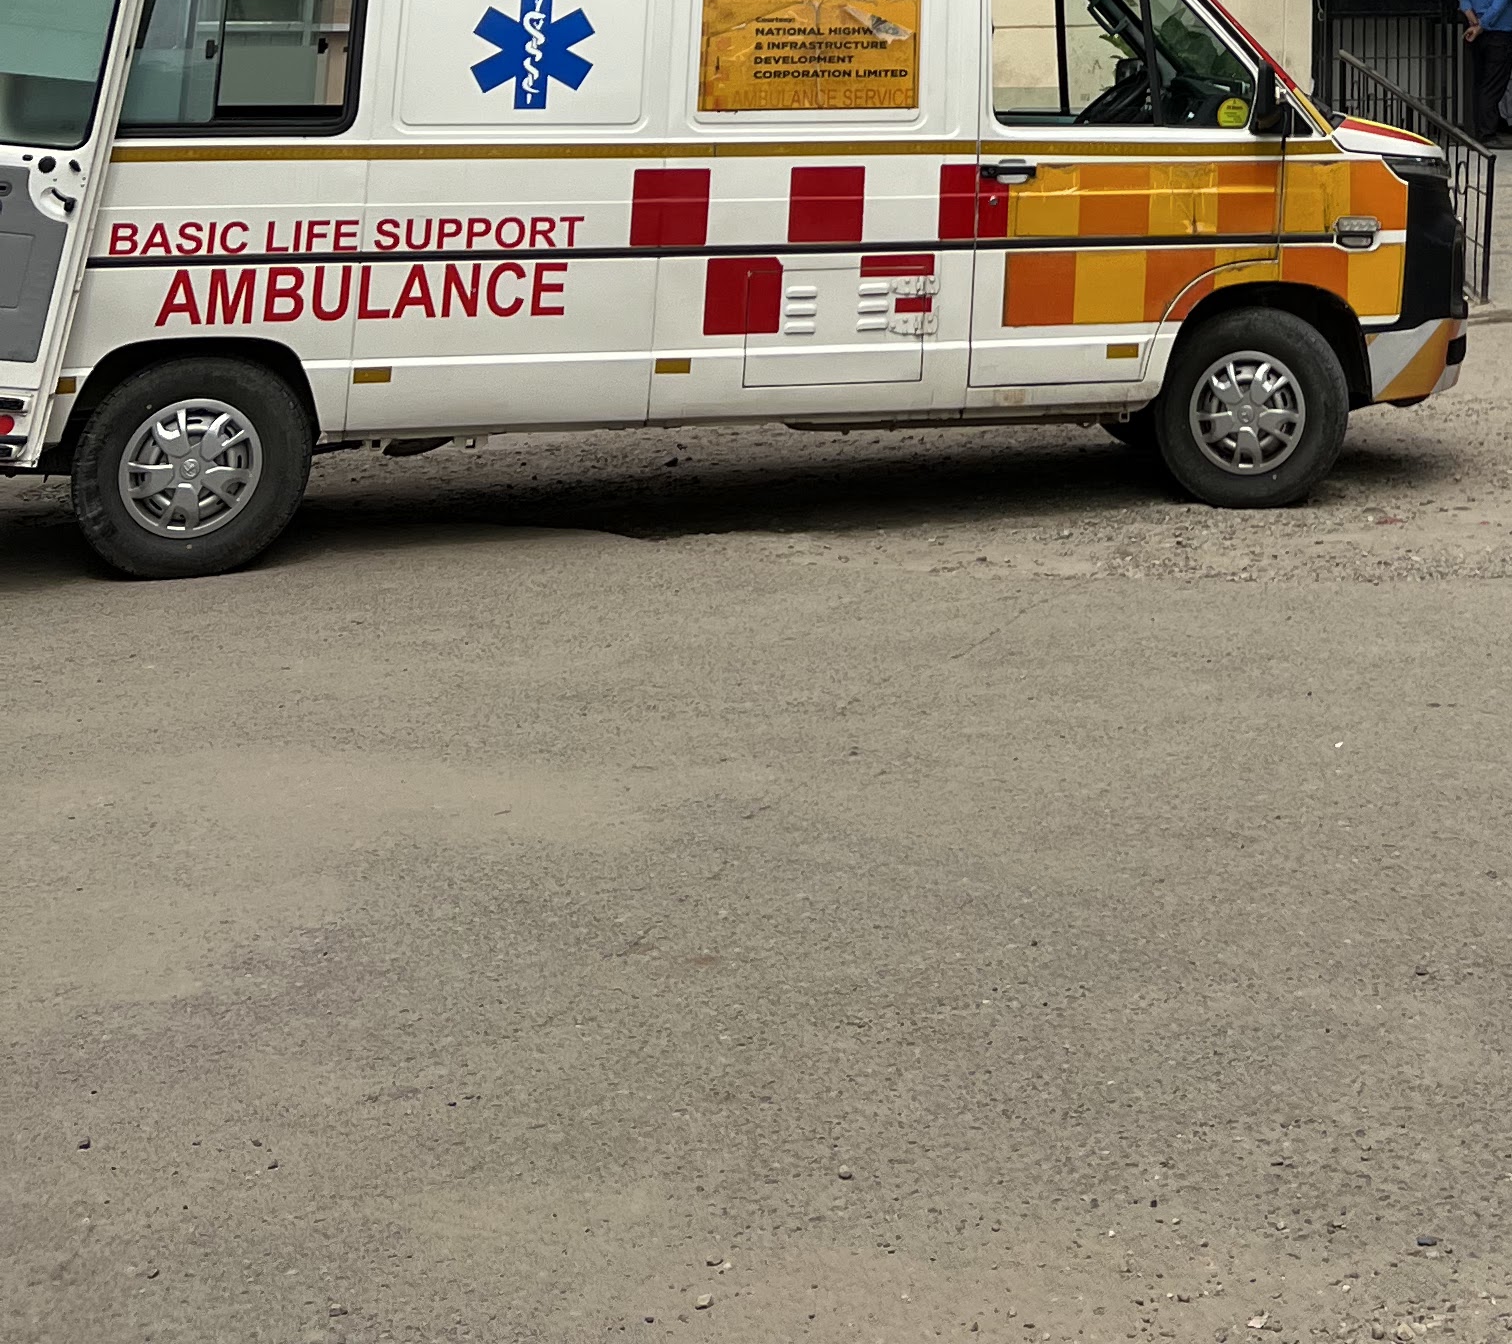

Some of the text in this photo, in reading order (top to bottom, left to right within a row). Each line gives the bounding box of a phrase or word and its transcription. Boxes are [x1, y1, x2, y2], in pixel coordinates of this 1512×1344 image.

[755, 26, 825, 37] NATIONAL
[754, 40, 888, 51] & INFRASTRUCTURE
[753, 54, 855, 65] DEVELOPMENT
[753, 68, 908, 79] CORPORATION LIMITED
[842, 87, 914, 107] SERVICE
[108, 216, 586, 256] BASIC LIFE SUPPORT
[154, 261, 569, 327] AMBULANCE
